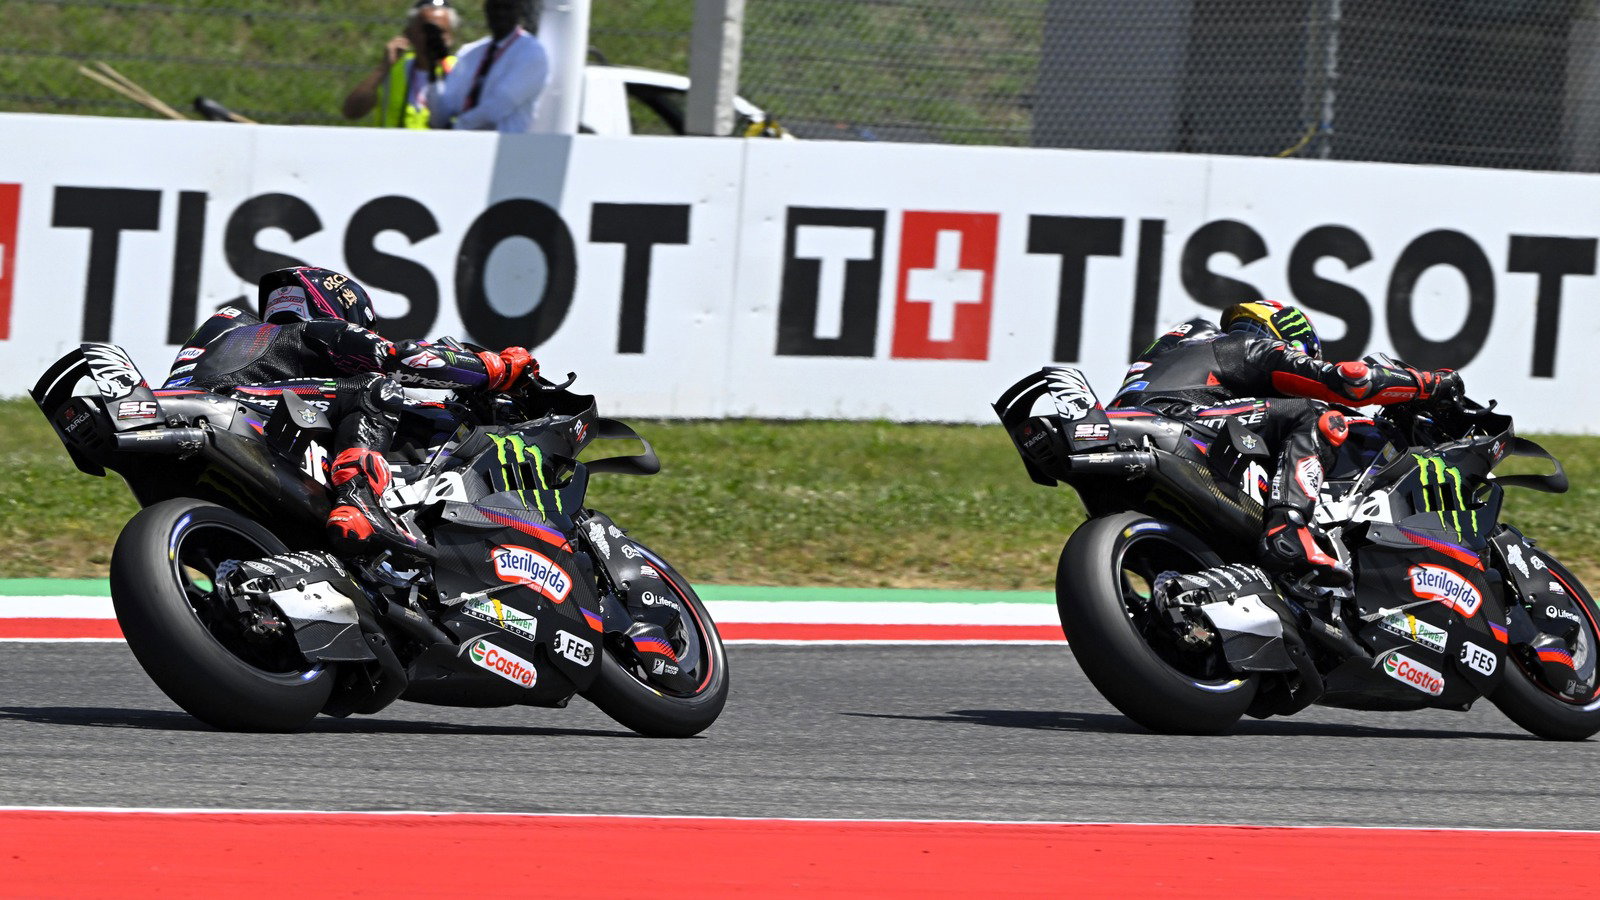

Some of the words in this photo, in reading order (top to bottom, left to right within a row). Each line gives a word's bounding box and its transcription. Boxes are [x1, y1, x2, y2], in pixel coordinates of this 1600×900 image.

[52, 185, 691, 354] TISSOT
[1027, 214, 1598, 378] TISSOT
[119, 401, 157, 413] SC
[65, 412, 91, 433] TARGA
[1075, 424, 1110, 434] SC
[500, 553, 565, 593] sterilgarda
[1416, 569, 1476, 608] sterilgarda
[506, 610, 533, 630] Power
[1419, 624, 1444, 643] Power
[566, 638, 592, 662] FES
[1472, 649, 1495, 672] FES
[485, 649, 535, 686] Castrol
